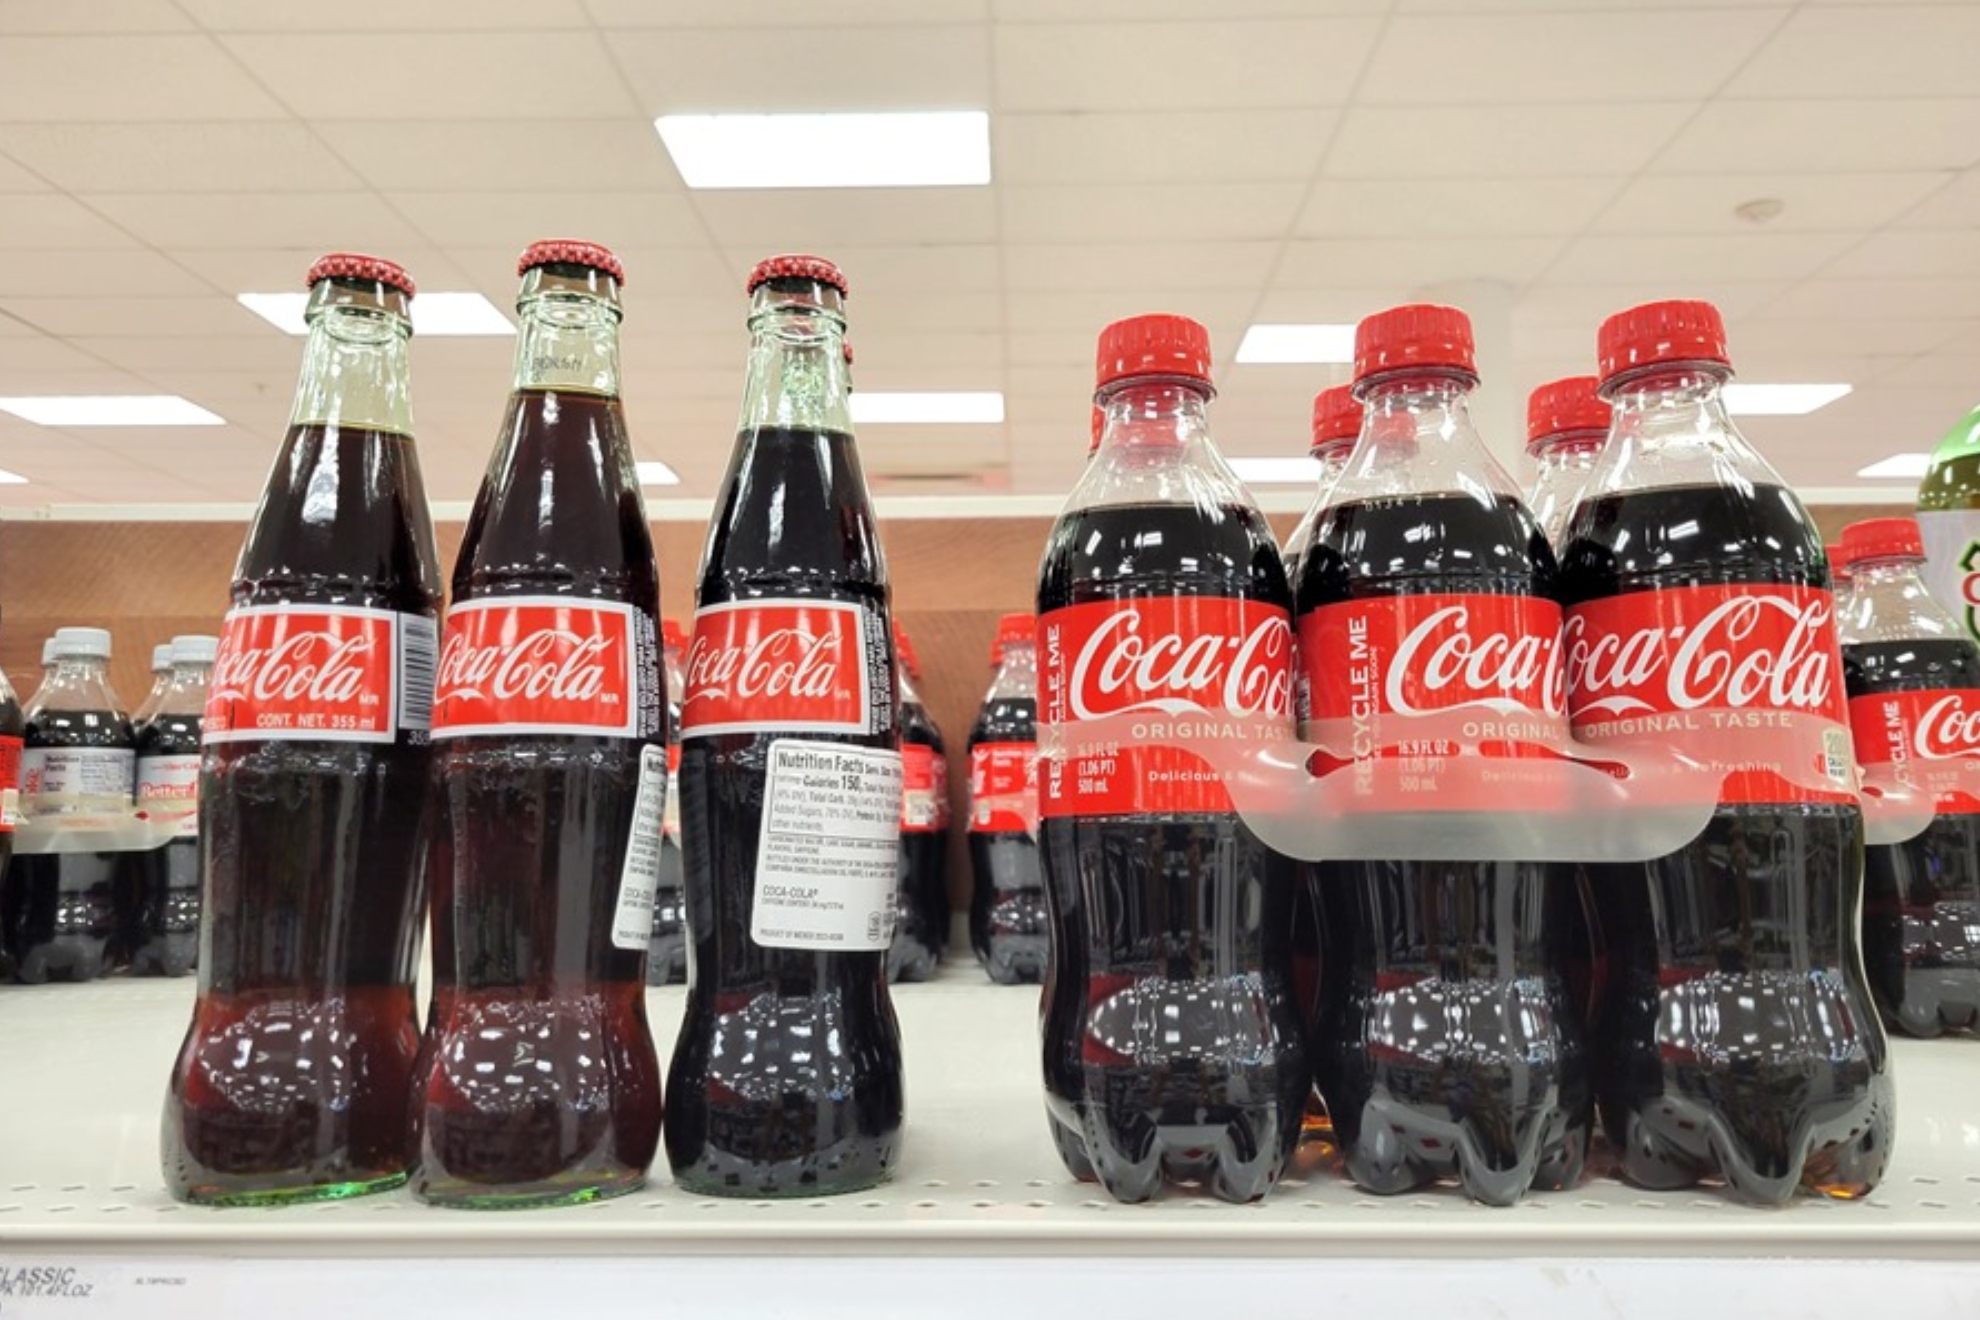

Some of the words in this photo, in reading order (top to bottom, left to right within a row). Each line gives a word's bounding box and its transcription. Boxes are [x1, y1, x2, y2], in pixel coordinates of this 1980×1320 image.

[1048, 624, 1060, 666] ME
[1349, 615, 1367, 659] ME
[435, 629, 615, 704] Coca-Cola
[685, 628, 843, 704] Coca-Cola
[256, 713, 292, 728] CONT.
[297, 713, 326, 728] NET.
[332, 715, 355, 728] 355
[360, 716, 376, 729] ml
[1586, 714, 1699, 738] ORIGINAL
[1710, 711, 1793, 729] TASTE
[1883, 701, 1902, 727] ME
[1049, 673, 1063, 798] REYCLE
[1132, 722, 1246, 739] ORIGINAL
[1350, 666, 1373, 794] RECYCLE
[1463, 722, 1560, 740] ORIGINAL
[778, 752, 833, 770] Nutrition
[834, 755, 864, 774] Facts
[1149, 769, 1219, 781] Delicious
[803, 775, 839, 789] Calories
